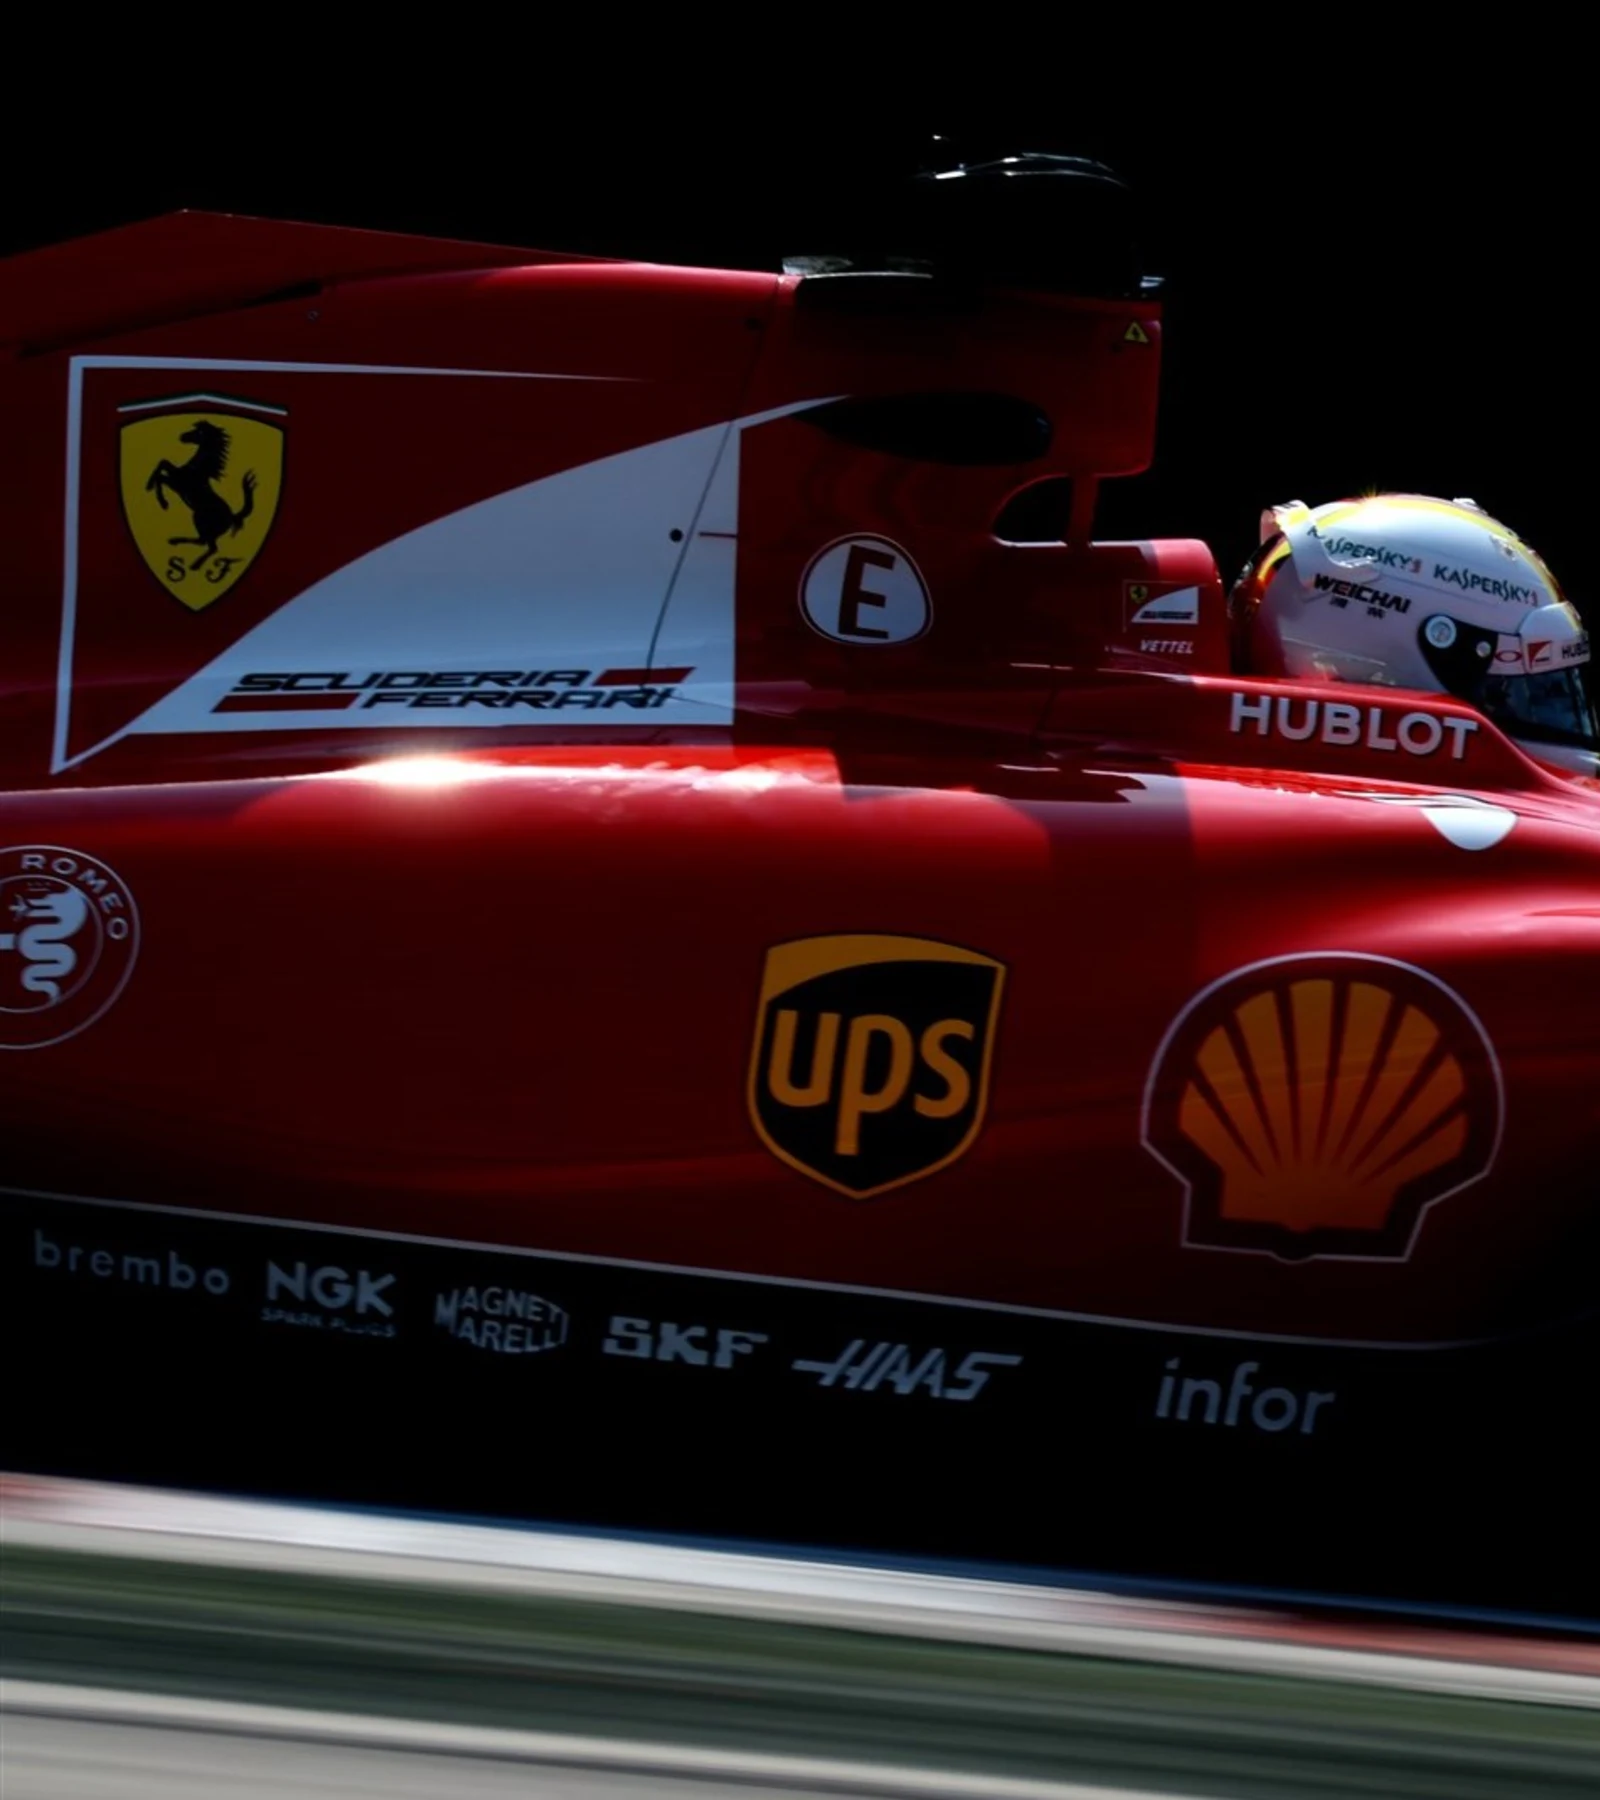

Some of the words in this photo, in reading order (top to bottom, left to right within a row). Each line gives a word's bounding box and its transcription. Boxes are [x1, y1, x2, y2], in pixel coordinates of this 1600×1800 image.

[838, 544, 896, 639] E
[1314, 573, 1412, 614] WEICHAI
[1140, 639, 1195, 655] VETTEL
[231, 670, 592, 692] SCUDERIA
[359, 687, 676, 710] FERRARI
[1229, 692, 1479, 760] HUBLOT
[20, 853, 129, 940] ROMEO
[766, 1009, 975, 1157] ups
[33, 1228, 232, 1296] brembo
[265, 1258, 397, 1318] NGK
[600, 1316, 770, 1370] SKF
[791, 1338, 1024, 1402] HAAS
[1154, 1357, 1337, 1436] infor
